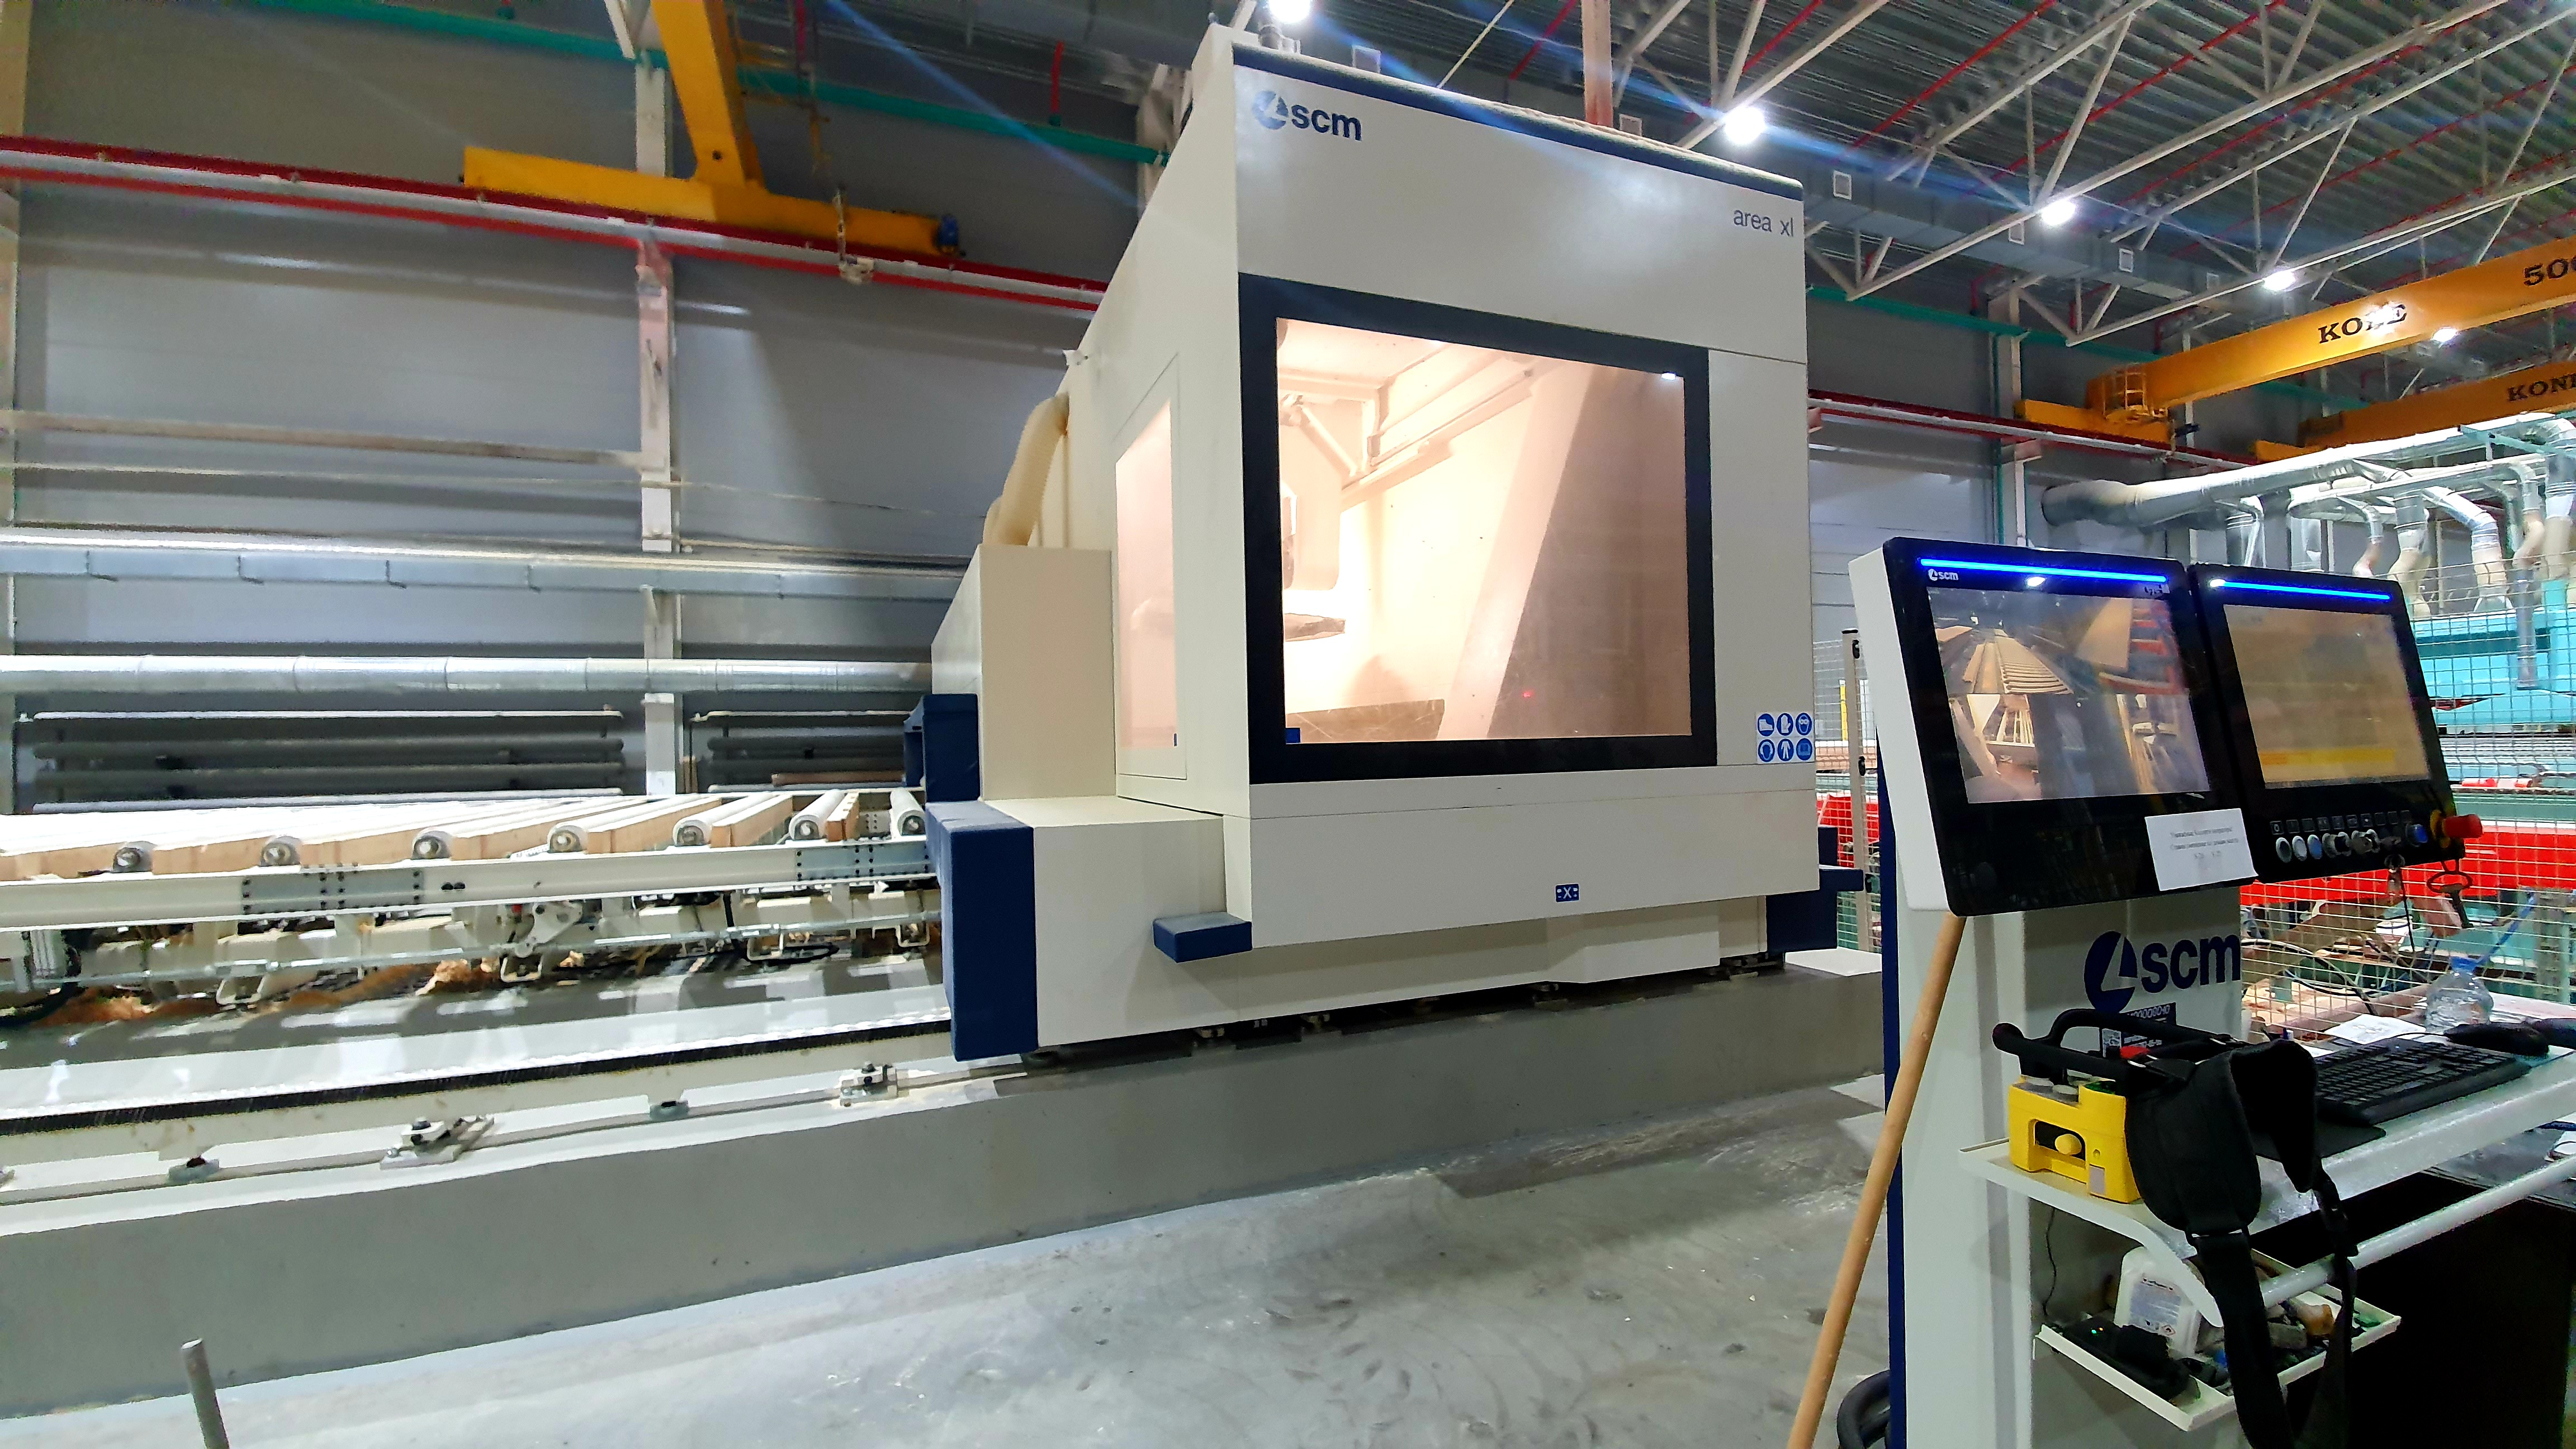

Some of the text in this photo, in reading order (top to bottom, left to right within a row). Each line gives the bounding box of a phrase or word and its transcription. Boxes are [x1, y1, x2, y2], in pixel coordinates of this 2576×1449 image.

[1291, 104, 1362, 141] scm
[1734, 210, 1793, 237] area xl
[2523, 255, 2576, 286] 50
[1938, 572, 1959, 580] scm
[2141, 934, 2241, 993] scm
